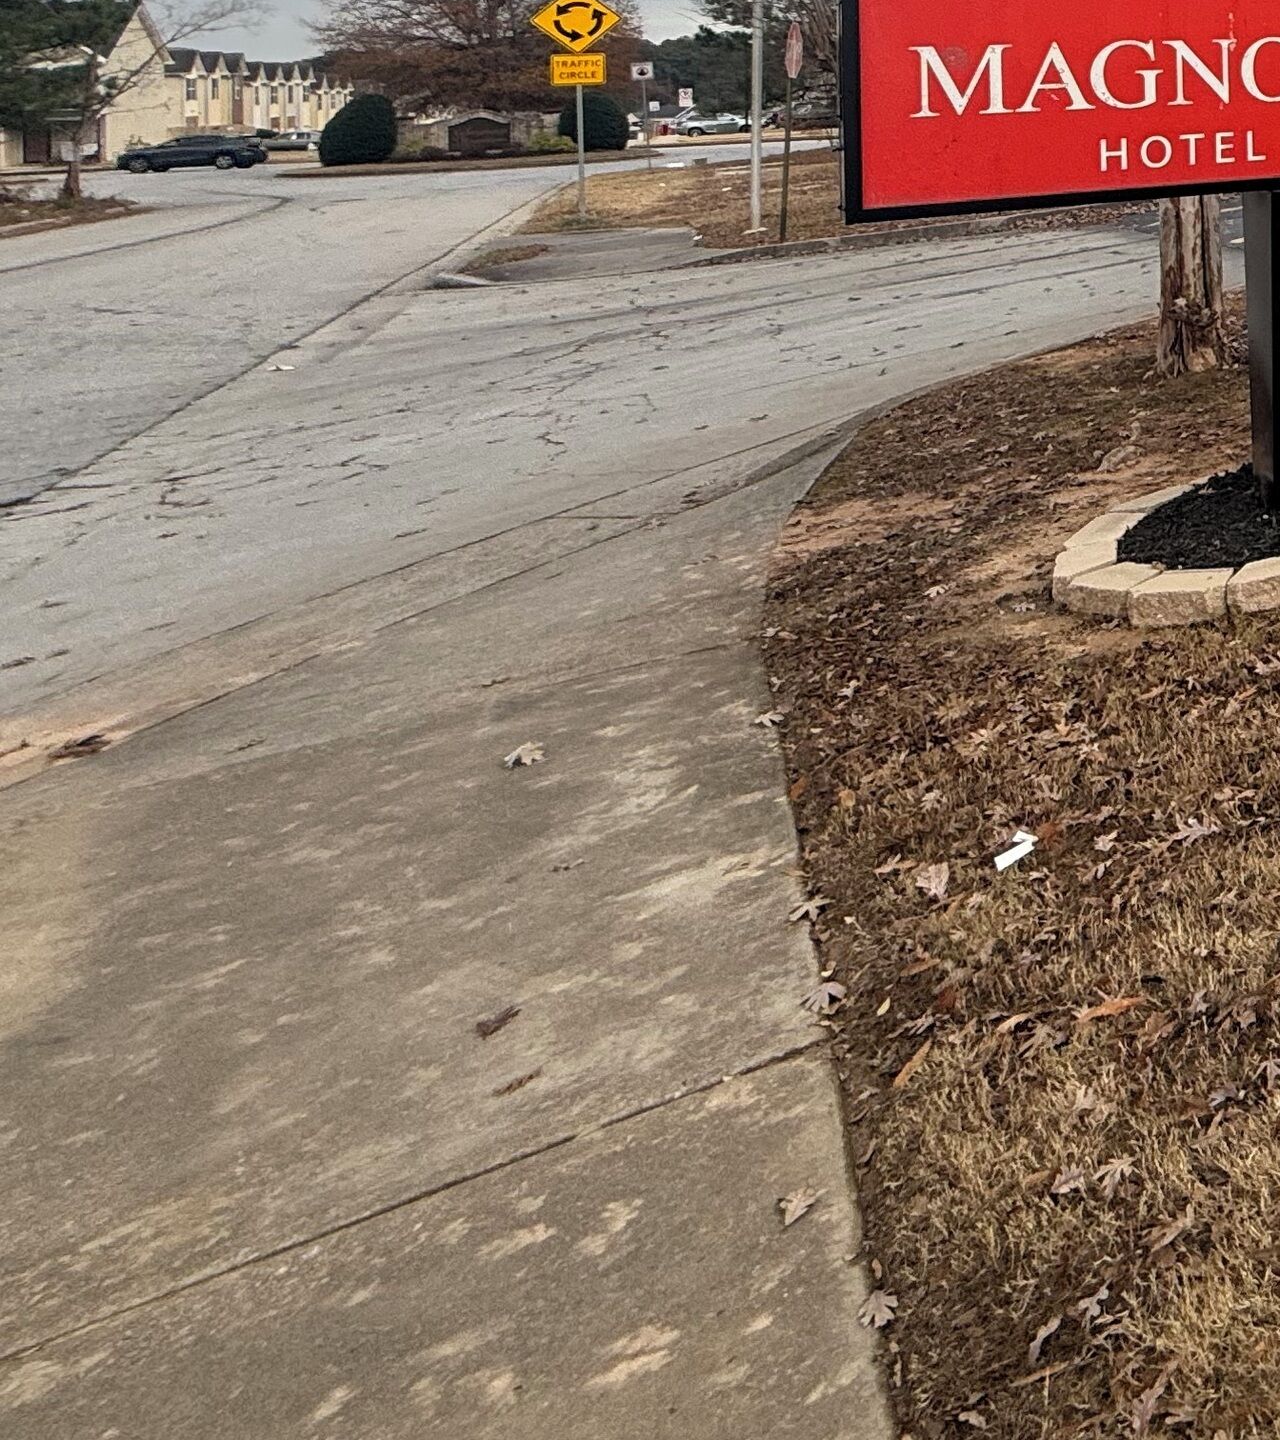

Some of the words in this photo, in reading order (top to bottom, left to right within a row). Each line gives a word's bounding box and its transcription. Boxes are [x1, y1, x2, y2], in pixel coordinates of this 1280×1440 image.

[555, 59, 601, 68] TRAFFIC
[559, 71, 597, 79] CIRCLE
[1100, 130, 1266, 172] HOTEL
